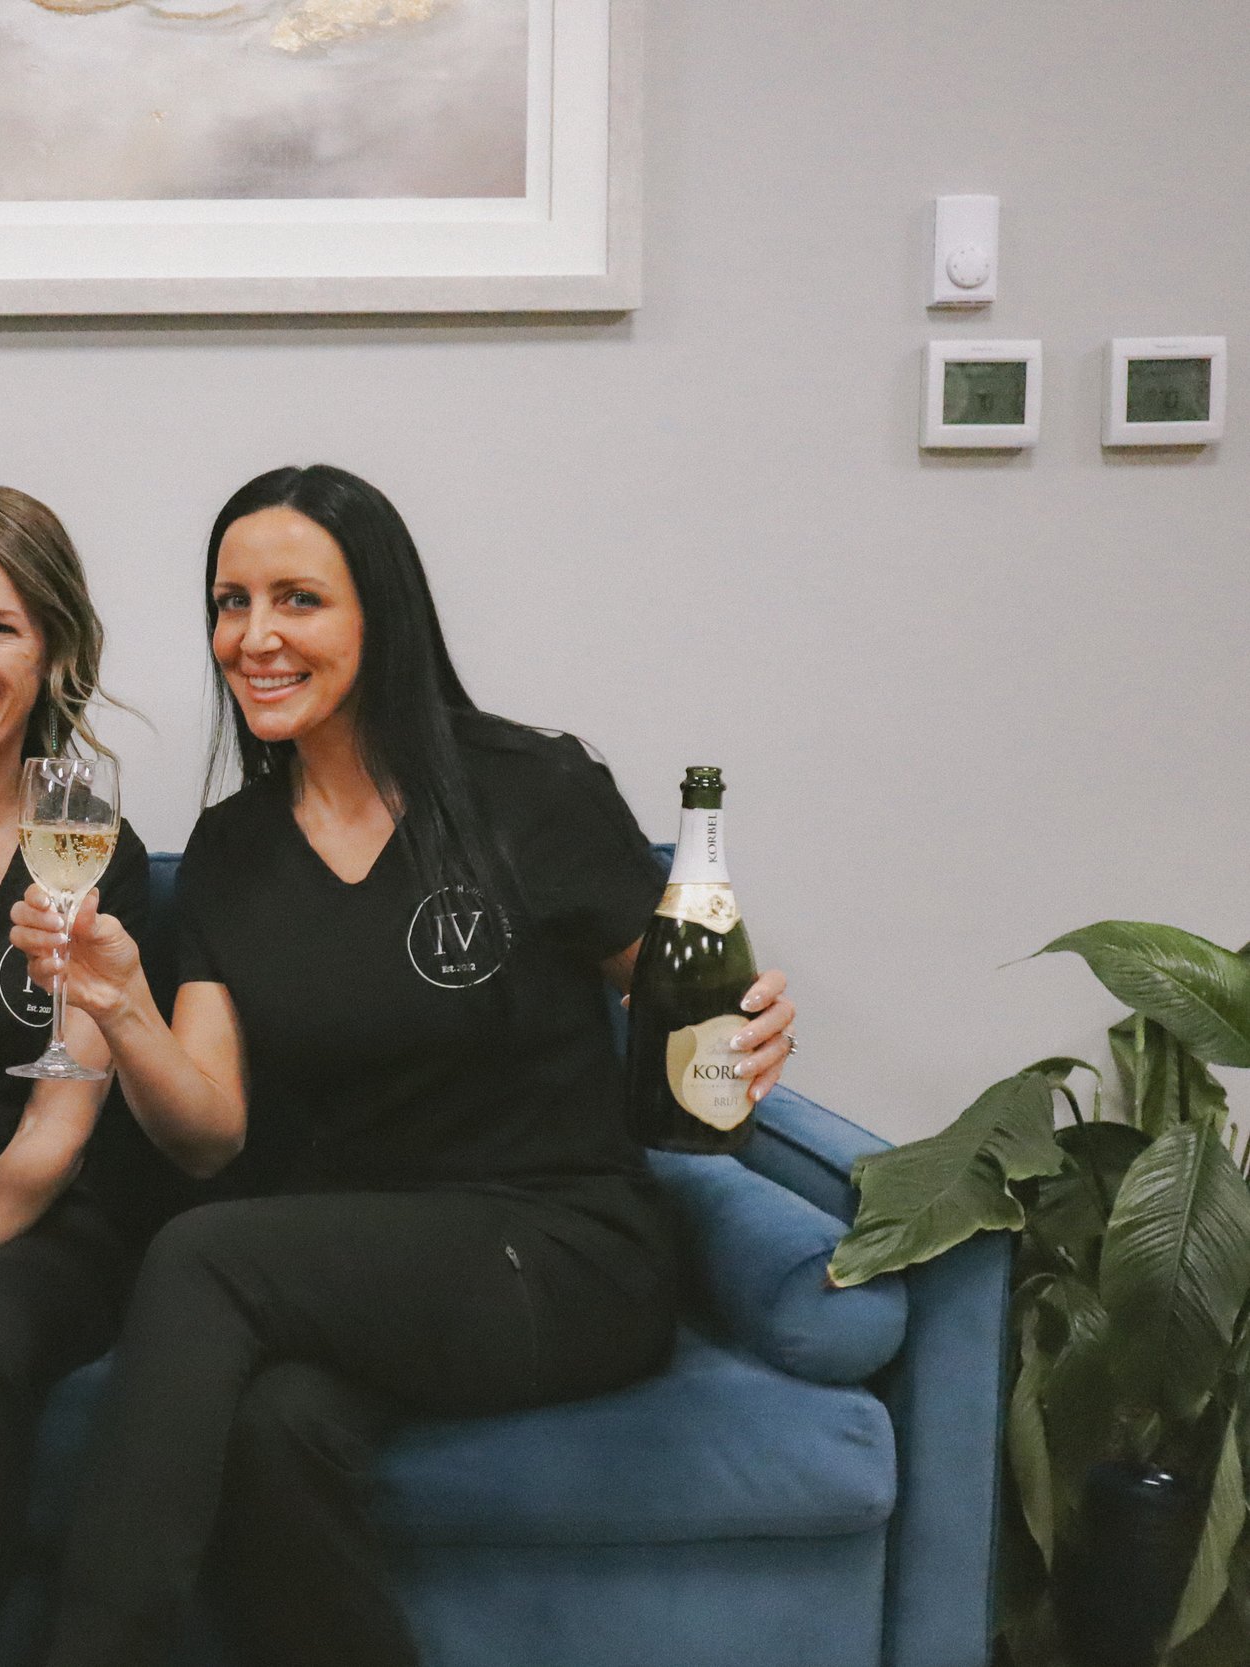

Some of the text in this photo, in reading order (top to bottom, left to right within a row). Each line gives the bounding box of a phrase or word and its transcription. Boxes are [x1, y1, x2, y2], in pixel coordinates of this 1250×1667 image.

[707, 813, 718, 864] KORBEL
[433, 910, 484, 956] IV
[714, 1096, 739, 1107] BRUT
